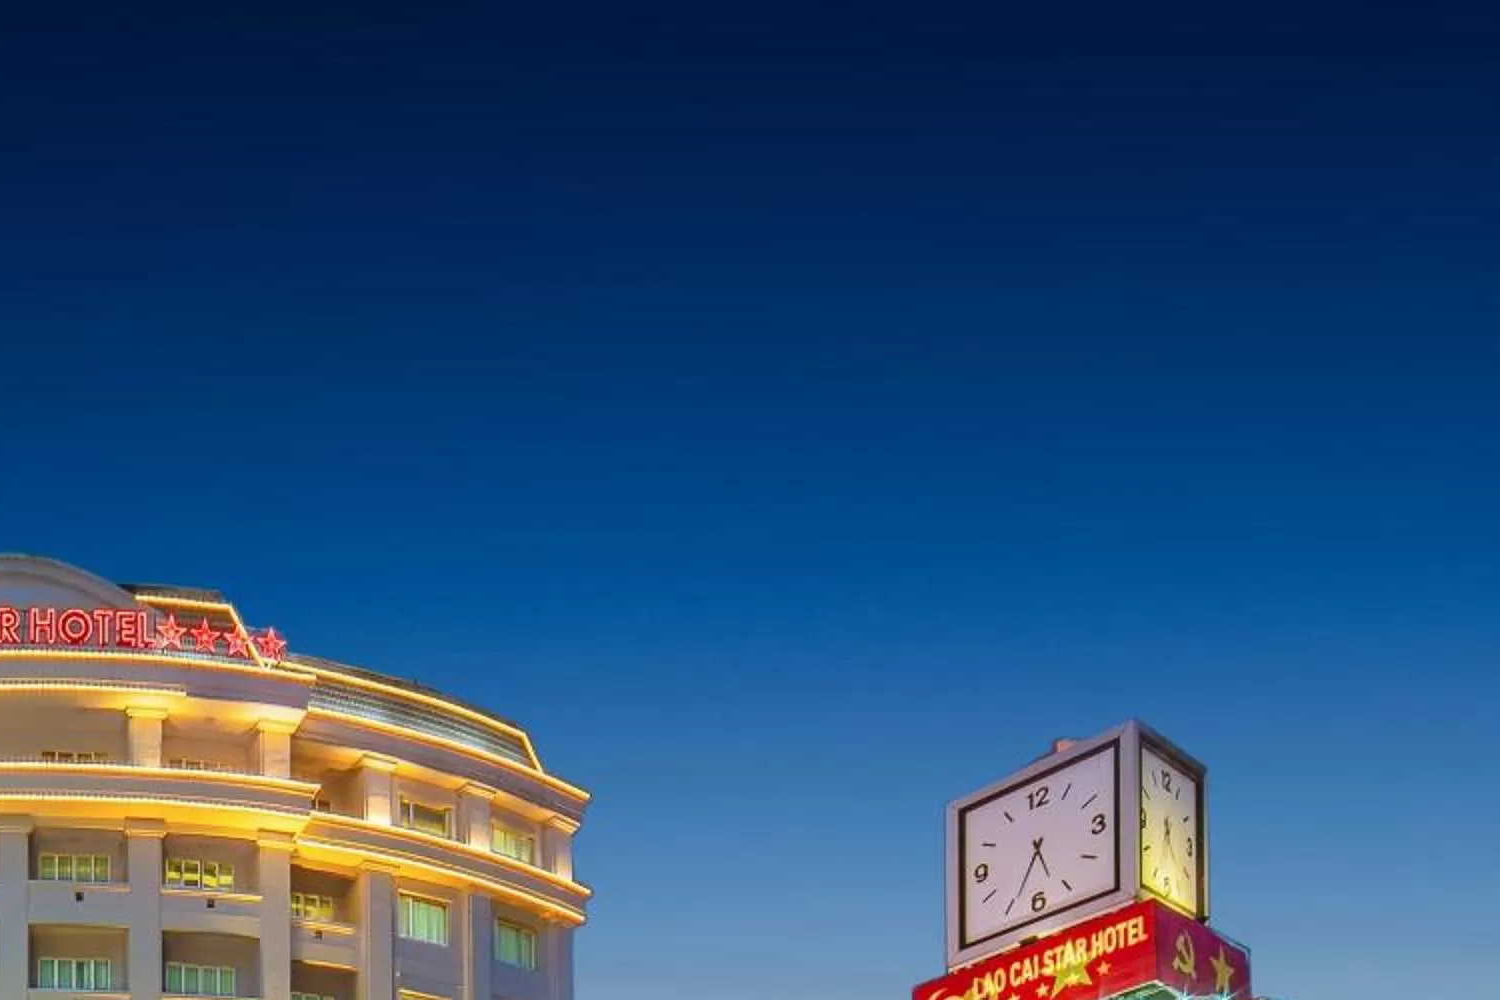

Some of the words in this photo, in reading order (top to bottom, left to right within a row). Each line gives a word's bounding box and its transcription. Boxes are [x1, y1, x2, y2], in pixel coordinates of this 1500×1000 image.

[28, 607, 156, 648] HOTEL
[1161, 769, 1172, 793] 12
[1027, 786, 1050, 811] 12
[1091, 812, 1107, 835] 3
[1186, 837, 1193, 858] 3
[974, 863, 989, 884] 9
[1163, 876, 1171, 898] 6
[1031, 891, 1046, 912] 6
[972, 968, 1007, 1000] LAO
[1010, 954, 1040, 988] CAI
[1042, 937, 1089, 974] STAR
[1091, 915, 1149, 958] HOTEL
